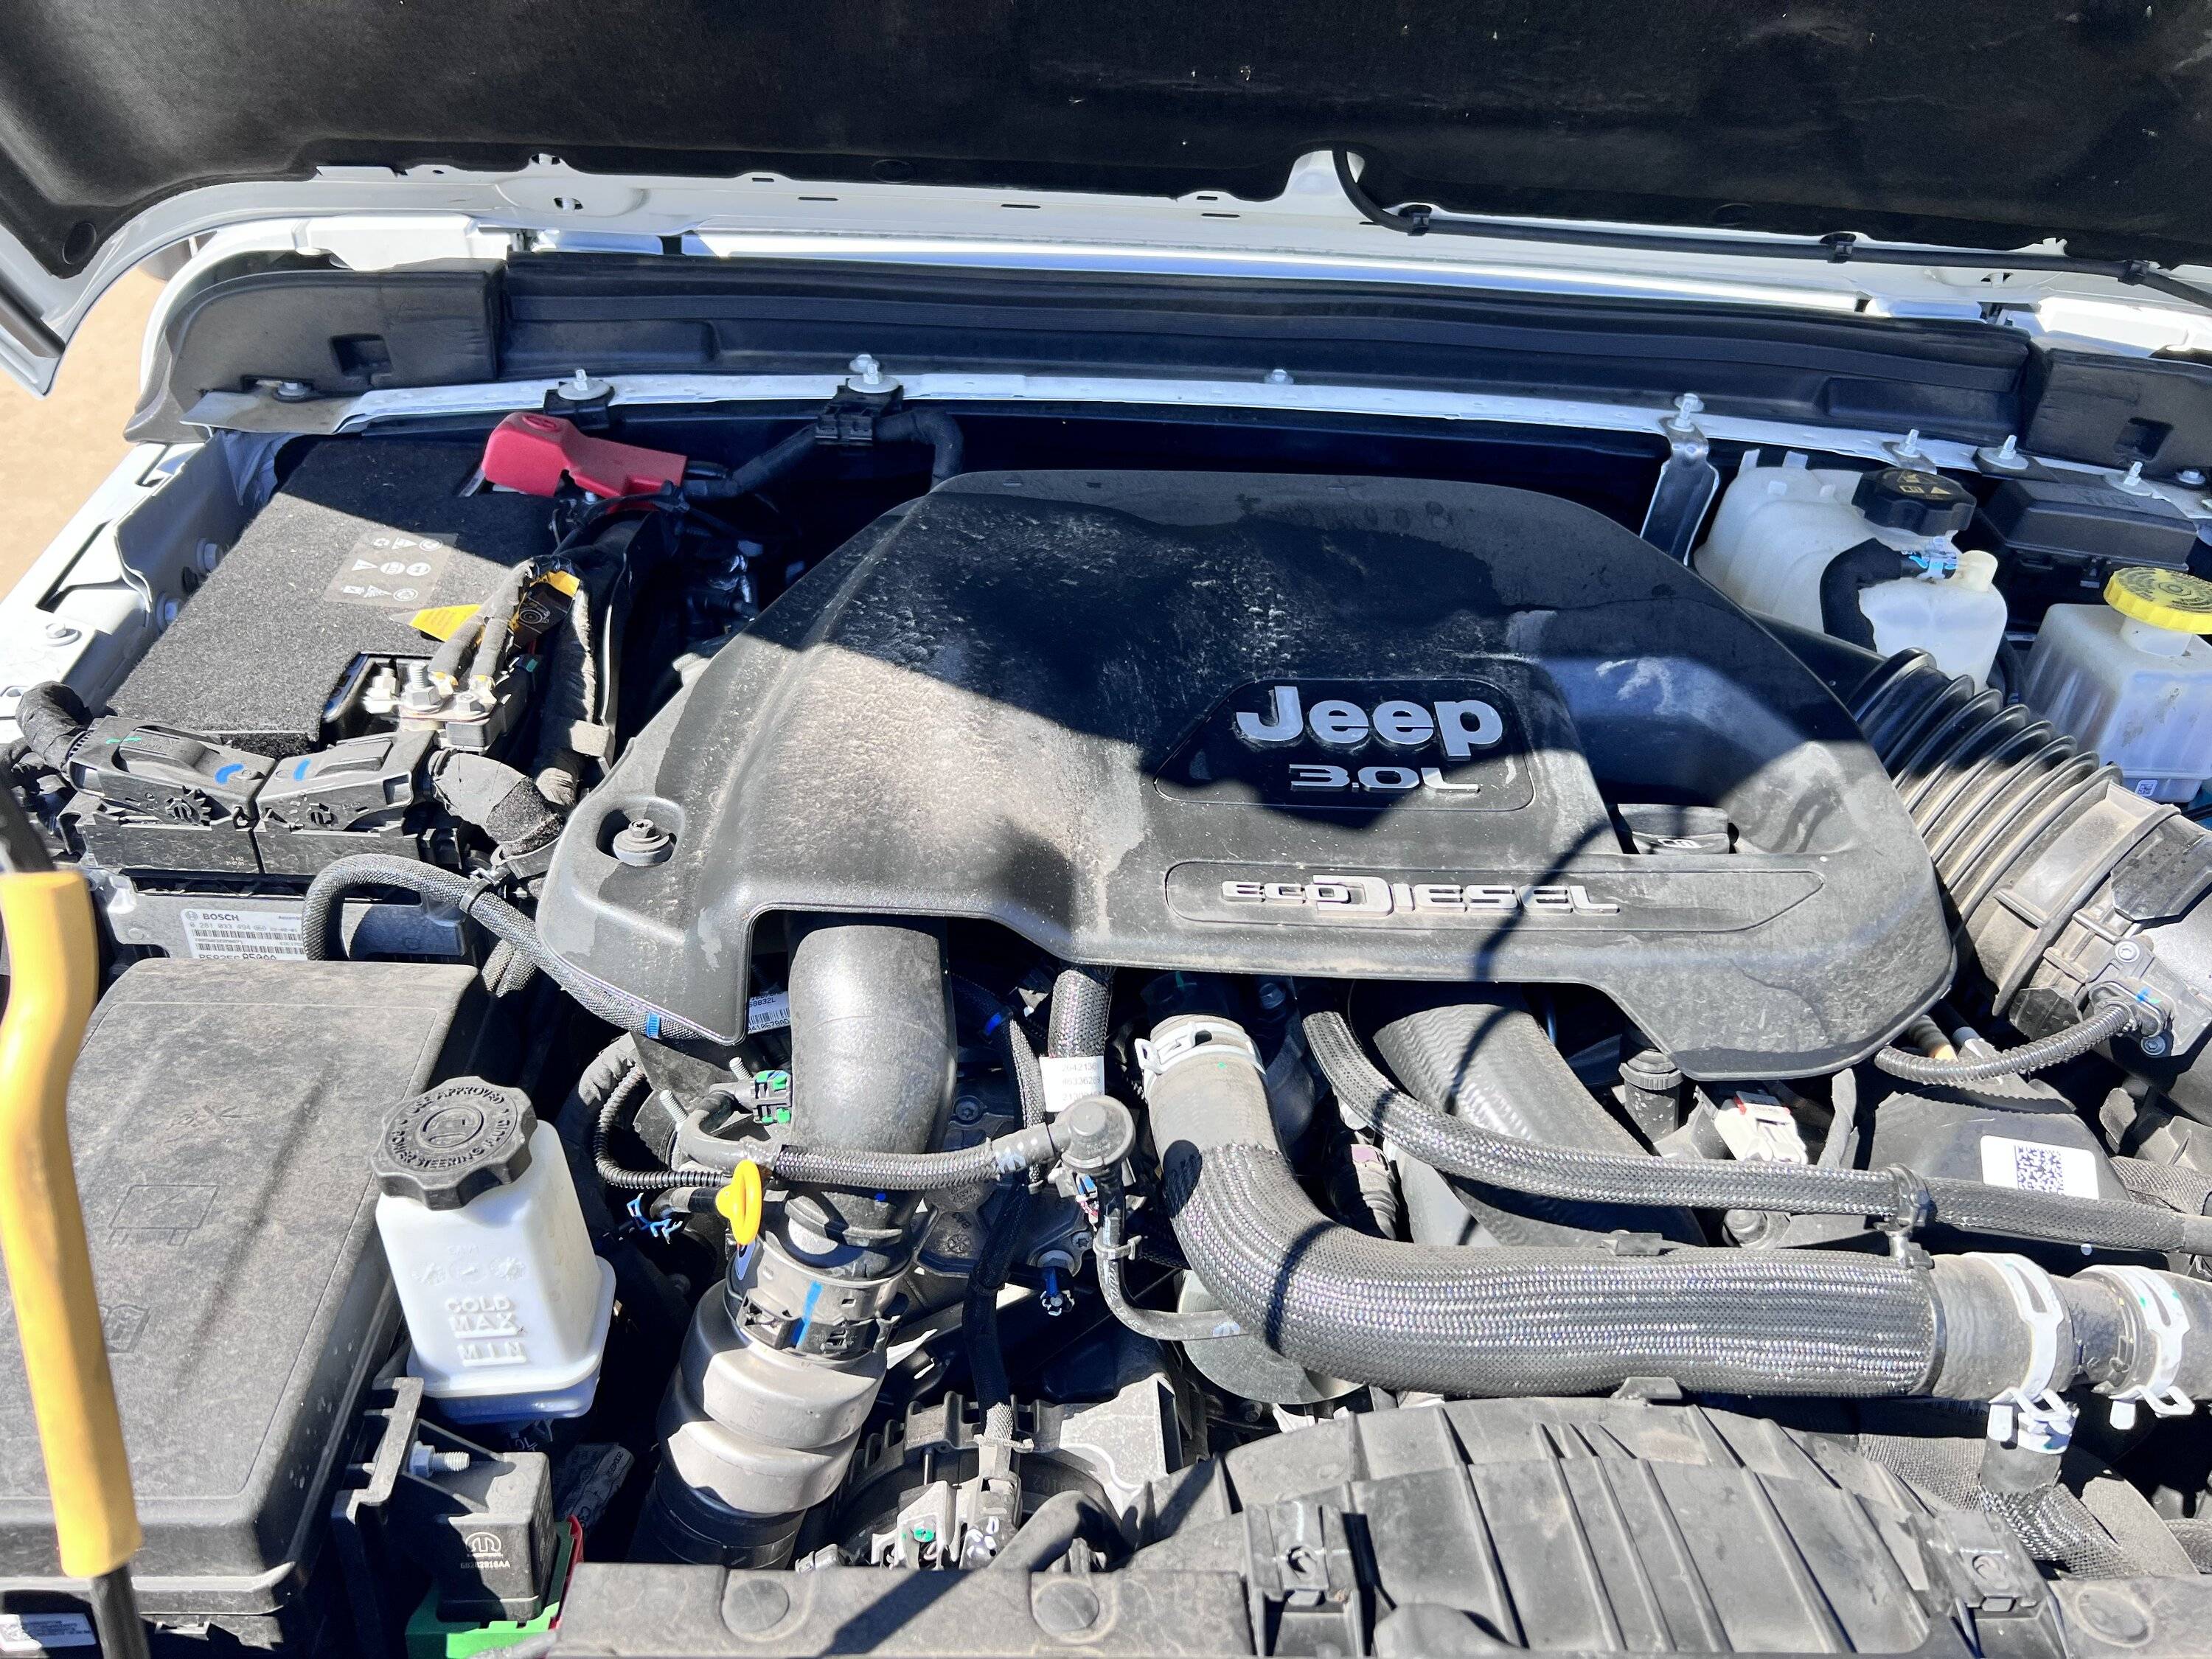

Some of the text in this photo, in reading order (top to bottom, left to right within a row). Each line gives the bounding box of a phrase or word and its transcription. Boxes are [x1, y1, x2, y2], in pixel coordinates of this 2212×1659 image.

[1236, 686, 1503, 759] Jeep
[1289, 764, 1480, 793] 3.0L
[202, 913, 240, 922] BOSCH
[407, 1086, 506, 1115] USE APPROVED
[391, 1119, 511, 1169] POWER STEERING FLUID
[444, 1295, 512, 1314] COLD
[448, 1312, 517, 1332] MAX
[456, 1340, 525, 1360] MIN
